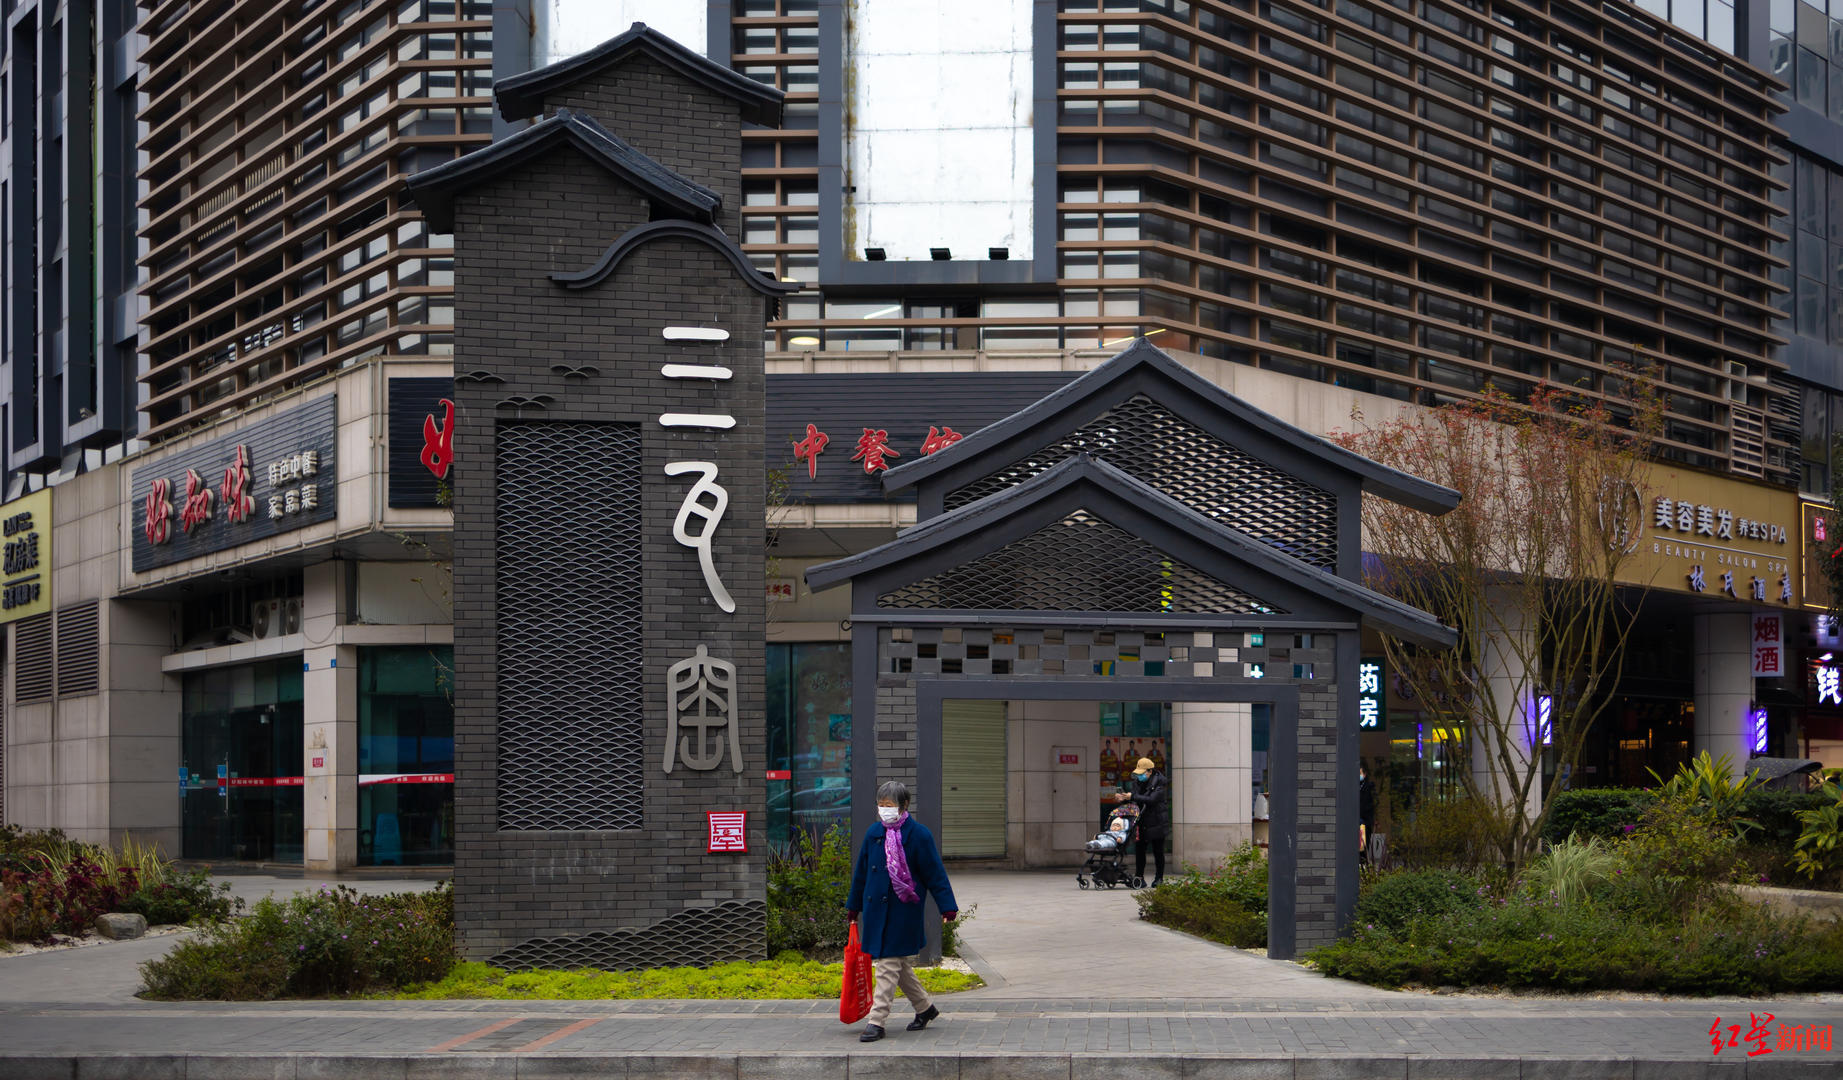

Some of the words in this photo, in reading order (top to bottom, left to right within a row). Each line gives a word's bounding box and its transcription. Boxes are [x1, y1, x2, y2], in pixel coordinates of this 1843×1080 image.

[268, 450, 318, 488] 特色中餐
[268, 484, 318, 520] 家常菜
[1655, 497, 1733, 541] 美容美发
[1738, 518, 1788, 545] 养生SPA
[1653, 542, 1706, 562] BEAUTY
[1718, 553, 1757, 569] SALON
[1767, 561, 1789, 574] SPA
[1754, 616, 1780, 673] 烟酒
[1360, 663, 1379, 728] 药房
